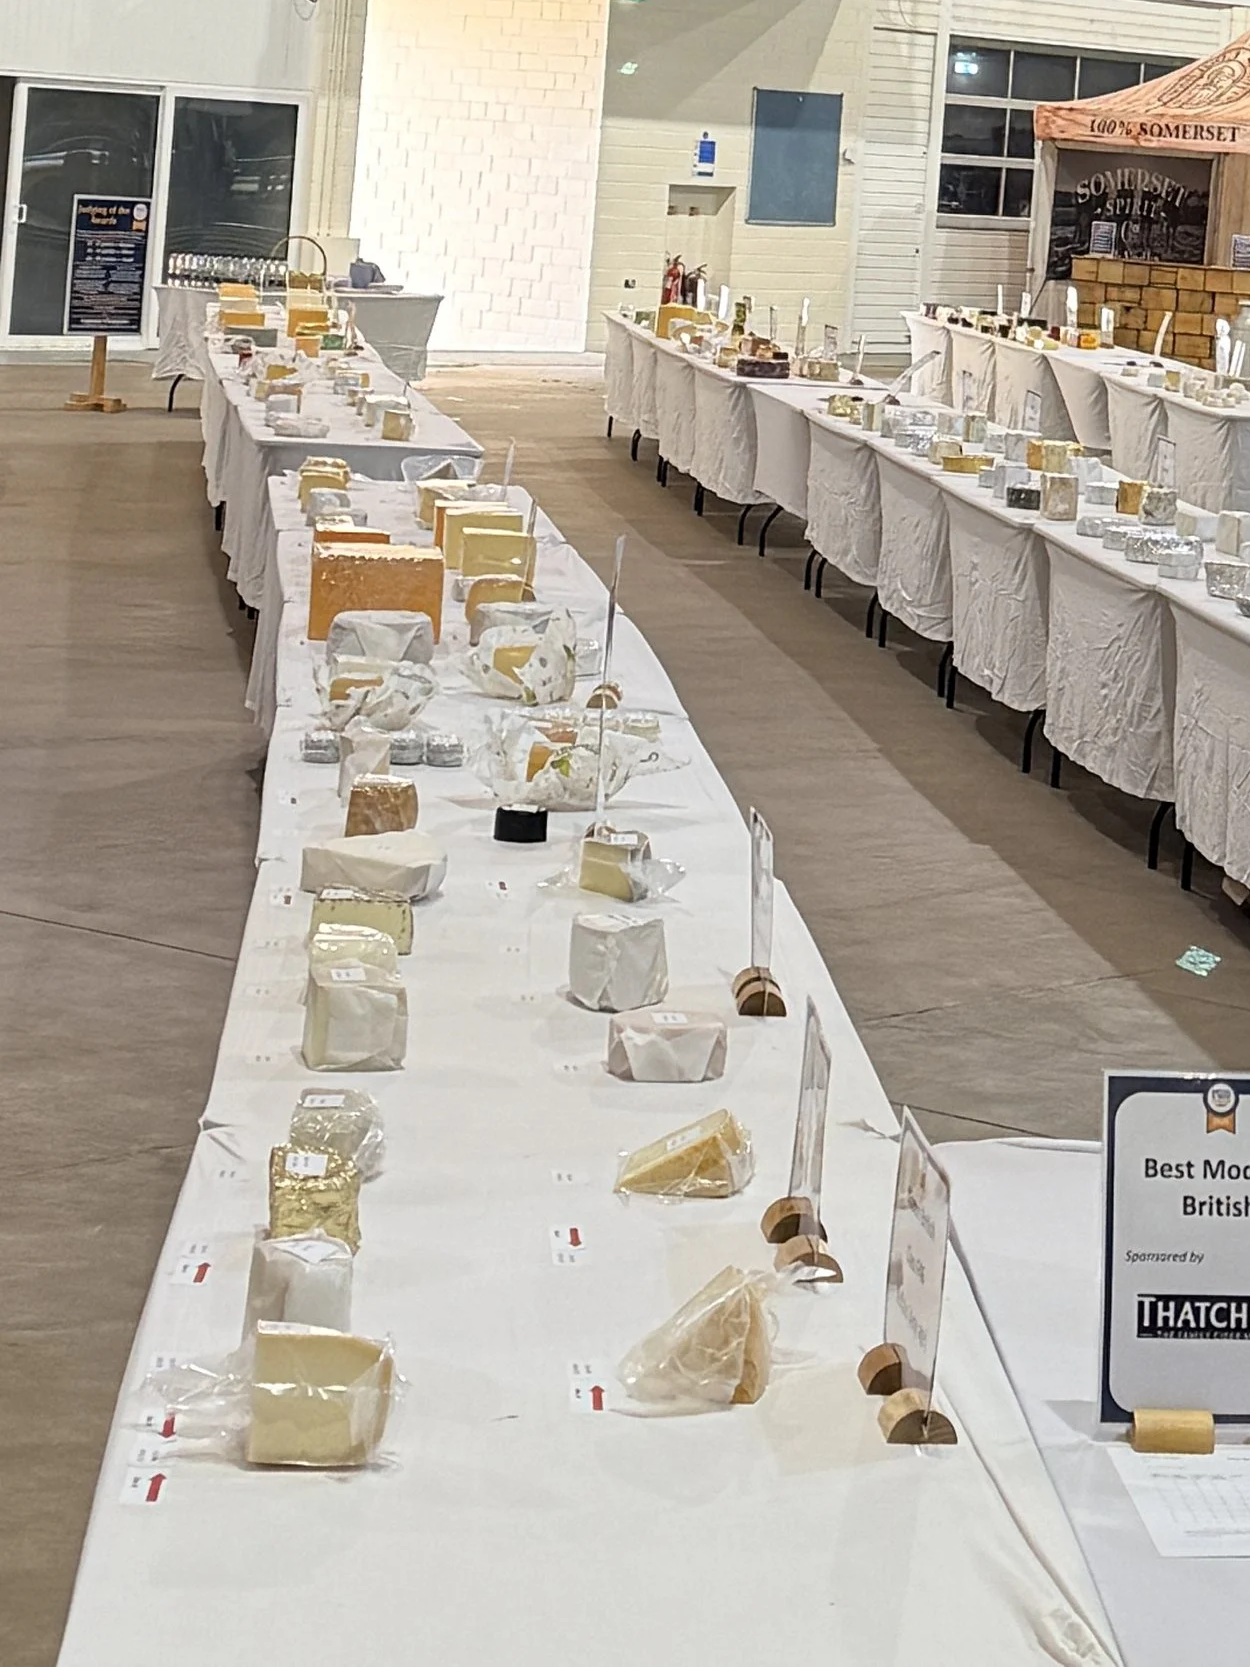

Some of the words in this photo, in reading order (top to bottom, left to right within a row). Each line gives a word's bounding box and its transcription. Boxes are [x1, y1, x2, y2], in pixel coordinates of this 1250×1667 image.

[1090, 118, 1132, 136] 100%
[1137, 122, 1240, 143] SOMERSET
[1076, 168, 1188, 207] SOMERSET
[1106, 198, 1158, 218] SPIRIT
[1144, 1158, 1195, 1179] Best
[1125, 1250, 1187, 1263] Sponsored
[1190, 1251, 1205, 1265] by
